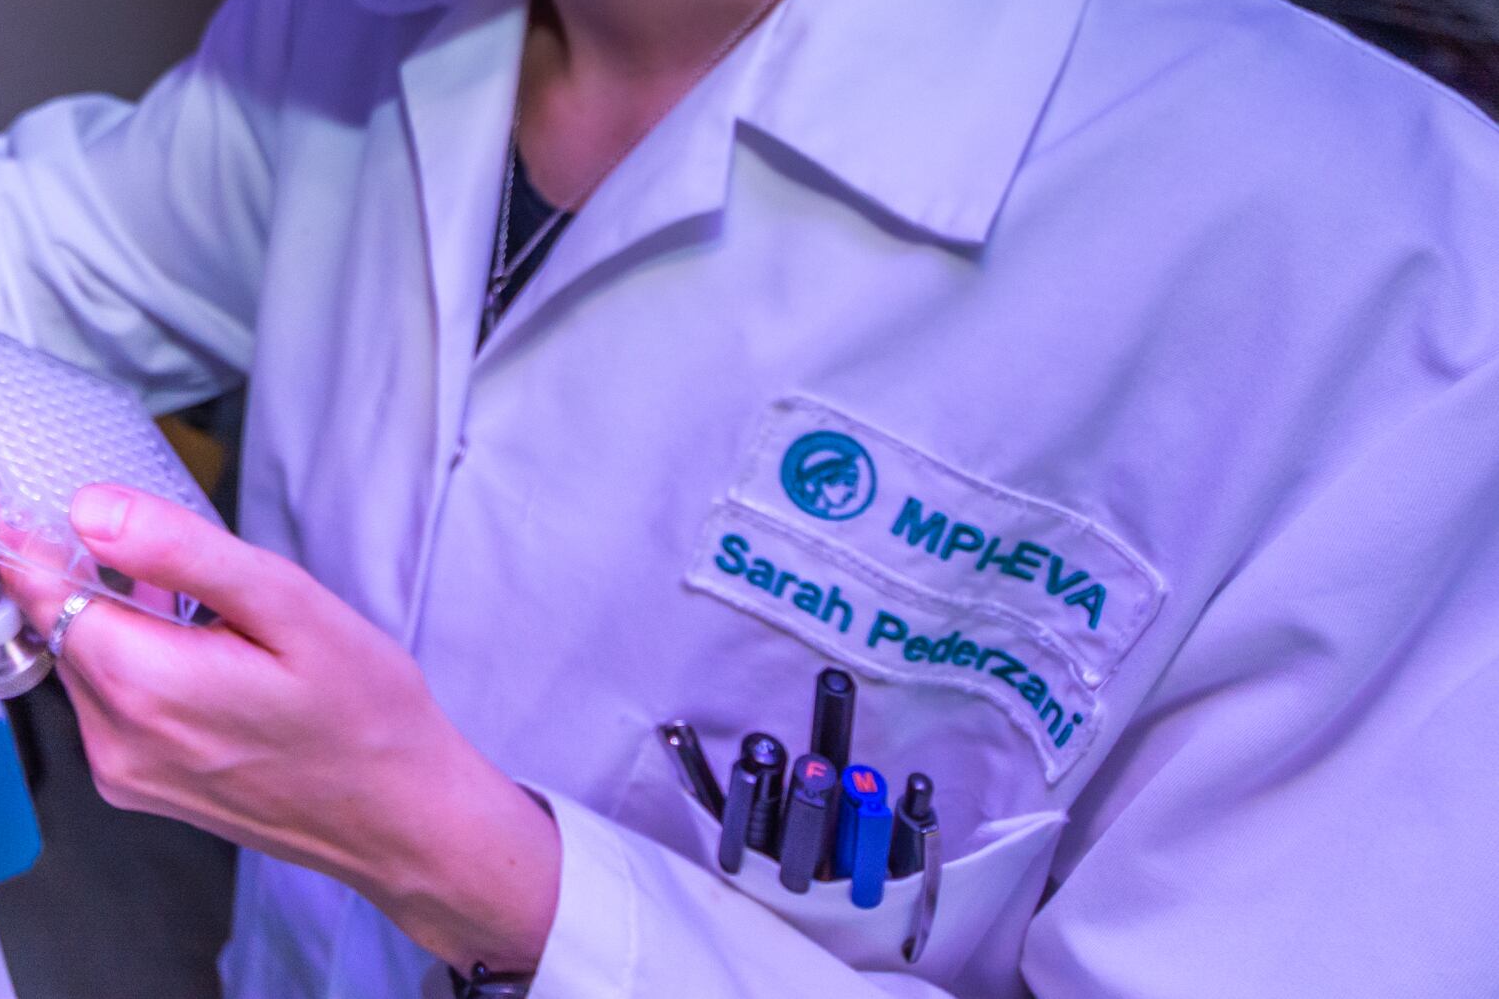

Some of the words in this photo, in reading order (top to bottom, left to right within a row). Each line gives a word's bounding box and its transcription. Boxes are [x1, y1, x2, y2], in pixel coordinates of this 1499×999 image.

[714, 533, 854, 634] Sarah
[866, 608, 1084, 749] Pederzani
[891, 497, 1108, 632] MPI-EVA
